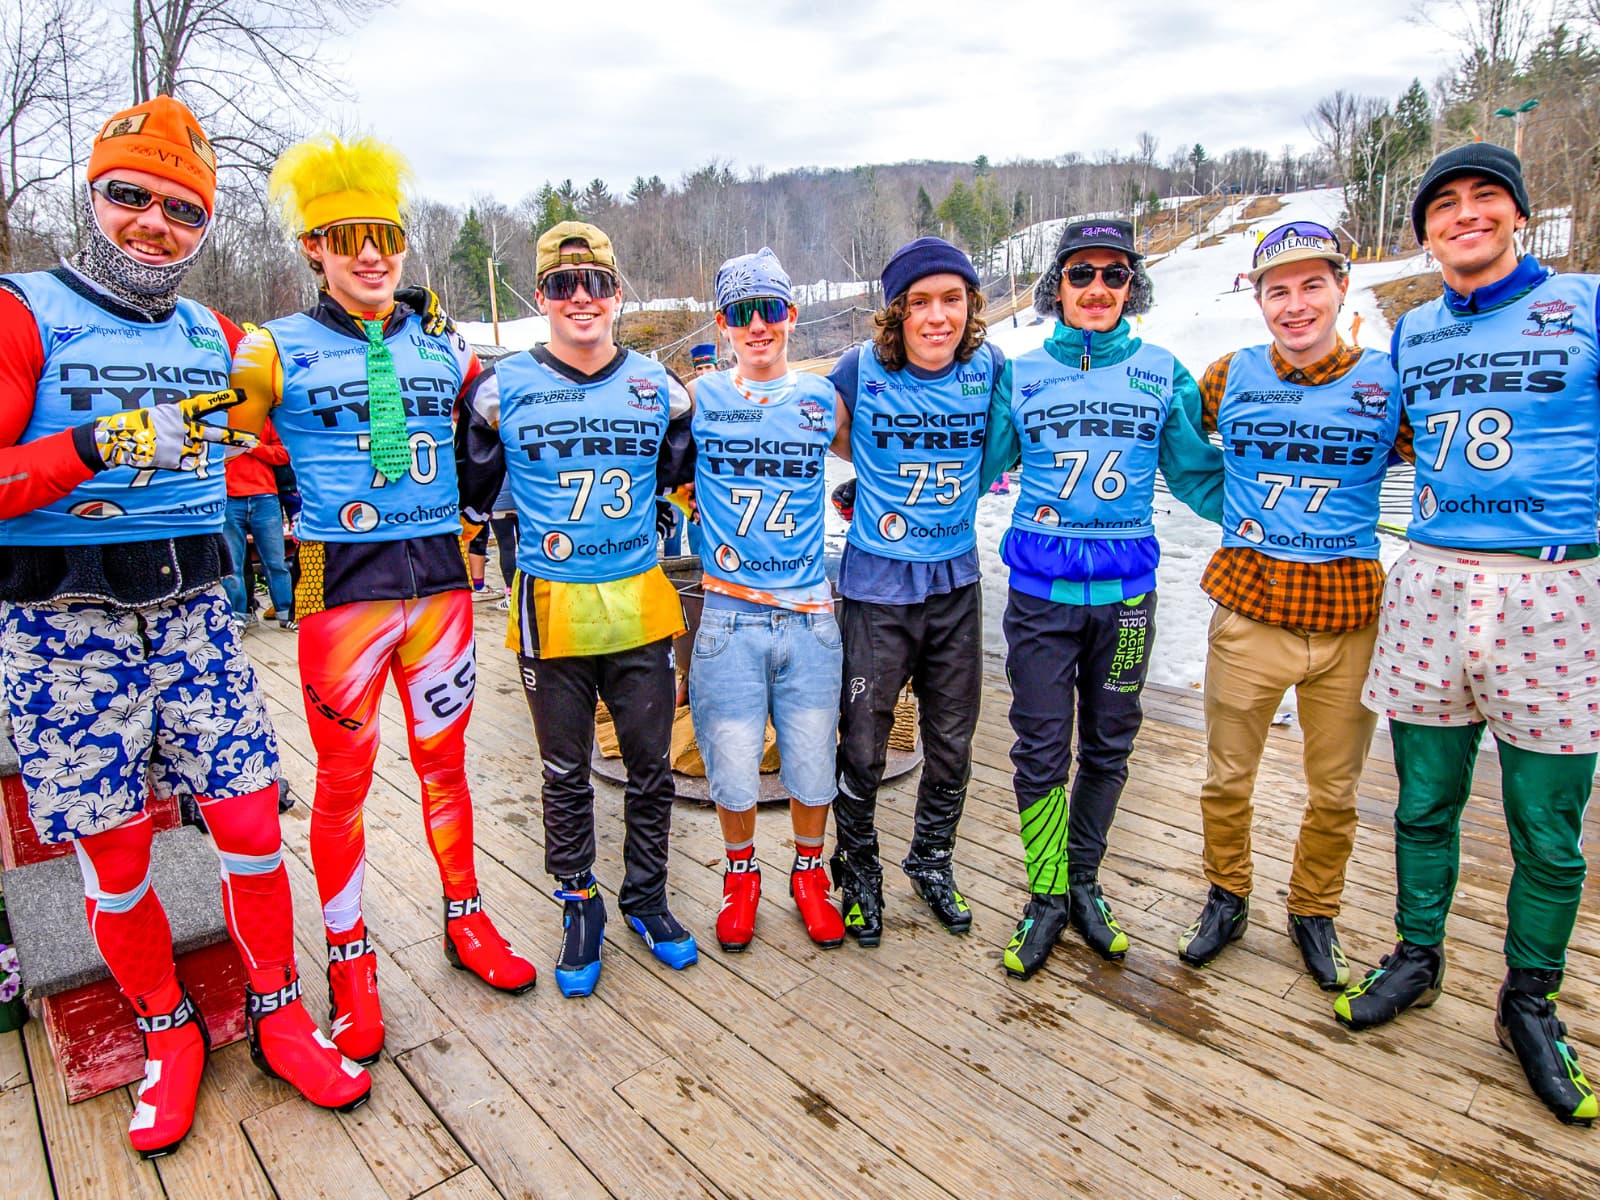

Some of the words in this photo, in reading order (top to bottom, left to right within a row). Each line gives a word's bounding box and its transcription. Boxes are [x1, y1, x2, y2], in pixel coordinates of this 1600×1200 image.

[158, 149, 183, 167] VT
[87, 324, 142, 338] Shipwright
[179, 323, 221, 340] Union
[1423, 325, 1473, 343] EXPRESS
[59, 362, 229, 387] nokian
[1126, 366, 1168, 387] Union
[1402, 349, 1569, 385] nokian
[961, 382, 990, 396] Bank
[1043, 372, 1086, 387] Shipwright
[1129, 377, 1164, 397] Bank
[1402, 370, 1567, 406] TYRES
[535, 392, 586, 404] EXPRESS
[1252, 393, 1304, 403] EXPRESS
[720, 412, 763, 421] EXPRESS
[872, 412, 986, 428] nokian
[1023, 400, 1160, 426] nokian
[518, 416, 660, 441] nokian
[872, 429, 985, 450] TYRES
[1025, 419, 1156, 444] TYRES
[1231, 420, 1379, 443] nokian
[1426, 408, 1513, 472] 78
[520, 437, 659, 462] TYRES
[705, 437, 824, 457] nokian
[1231, 439, 1375, 466] TYRES
[707, 456, 820, 479] TYRES
[1053, 450, 1127, 501] 76
[558, 467, 633, 522] 73
[898, 461, 964, 507] 75
[1256, 471, 1341, 514] 77
[384, 502, 458, 525] cochran's
[730, 487, 797, 539] 74
[1440, 494, 1546, 514] cochran's
[910, 519, 970, 539] cochran's
[1268, 531, 1357, 549] cochran's
[577, 532, 649, 557] cochran's
[743, 554, 814, 572] cochran's
[1456, 557, 1469, 565] TEAM
[1109, 617, 1129, 680] PROJECT
[1123, 617, 1139, 670] RACING
[1134, 616, 1147, 664] GREEN
